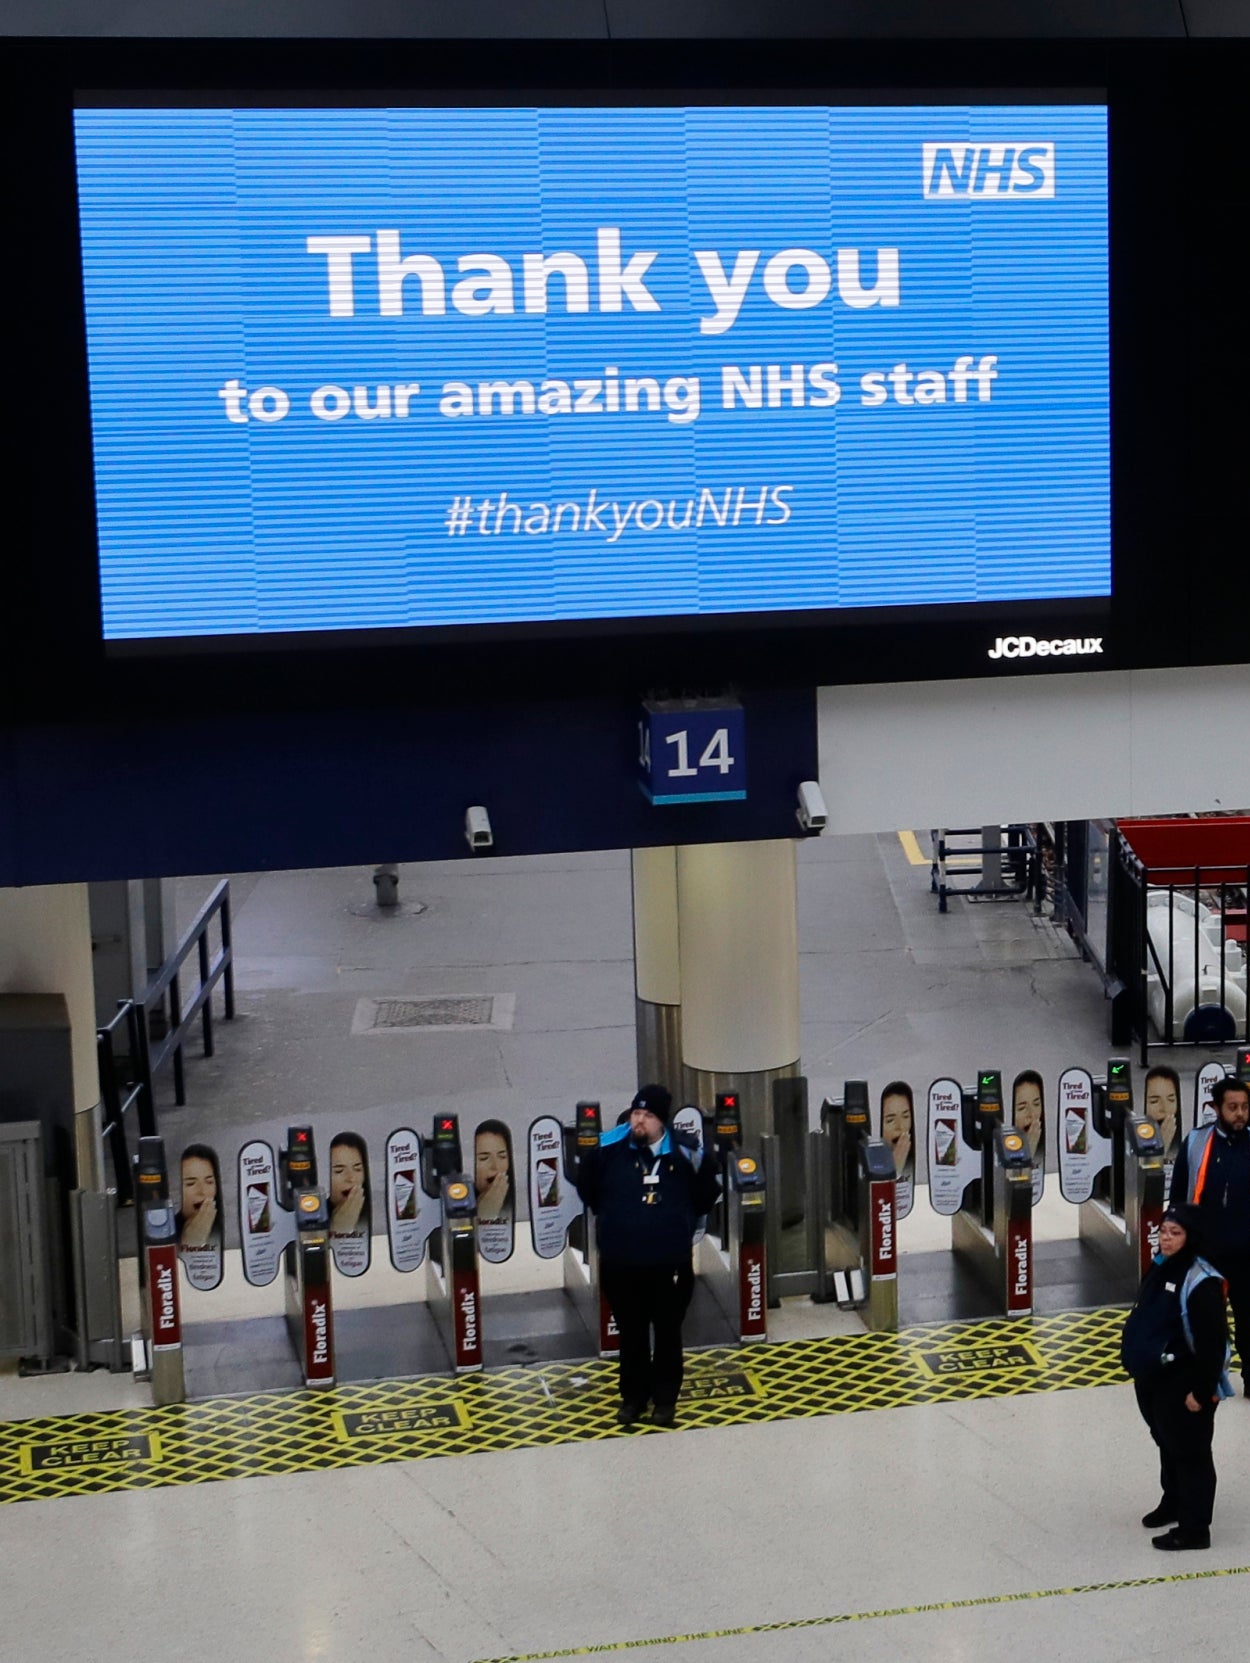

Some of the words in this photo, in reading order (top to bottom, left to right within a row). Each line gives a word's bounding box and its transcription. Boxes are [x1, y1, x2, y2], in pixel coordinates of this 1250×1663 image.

[928, 147, 1052, 194] NHS
[307, 229, 662, 317] Thank
[696, 246, 901, 335] you
[220, 377, 291, 424] to
[310, 380, 419, 420] our
[439, 366, 702, 424] amazing
[721, 364, 842, 411] NHS
[859, 356, 999, 407] staff
[443, 485, 794, 542] #thankyouNHS
[988, 635, 1103, 660] JCDecaux
[665, 728, 734, 774] 14
[1063, 1082, 1083, 1090] Tired
[1066, 1091, 1090, 1100] Tired?
[932, 1093, 952, 1101] Tired
[935, 1103, 959, 1112] Tired?
[937, 1354, 1028, 1373] CLEAR
[939, 1347, 1011, 1363] KEEP
[352, 1415, 452, 1436] CLEAR
[360, 1407, 437, 1425] KEEP
[50, 1438, 130, 1457] KEEP
[41, 1448, 142, 1468] CLEAR
[1172, 1569, 1220, 1582] PLEASE
